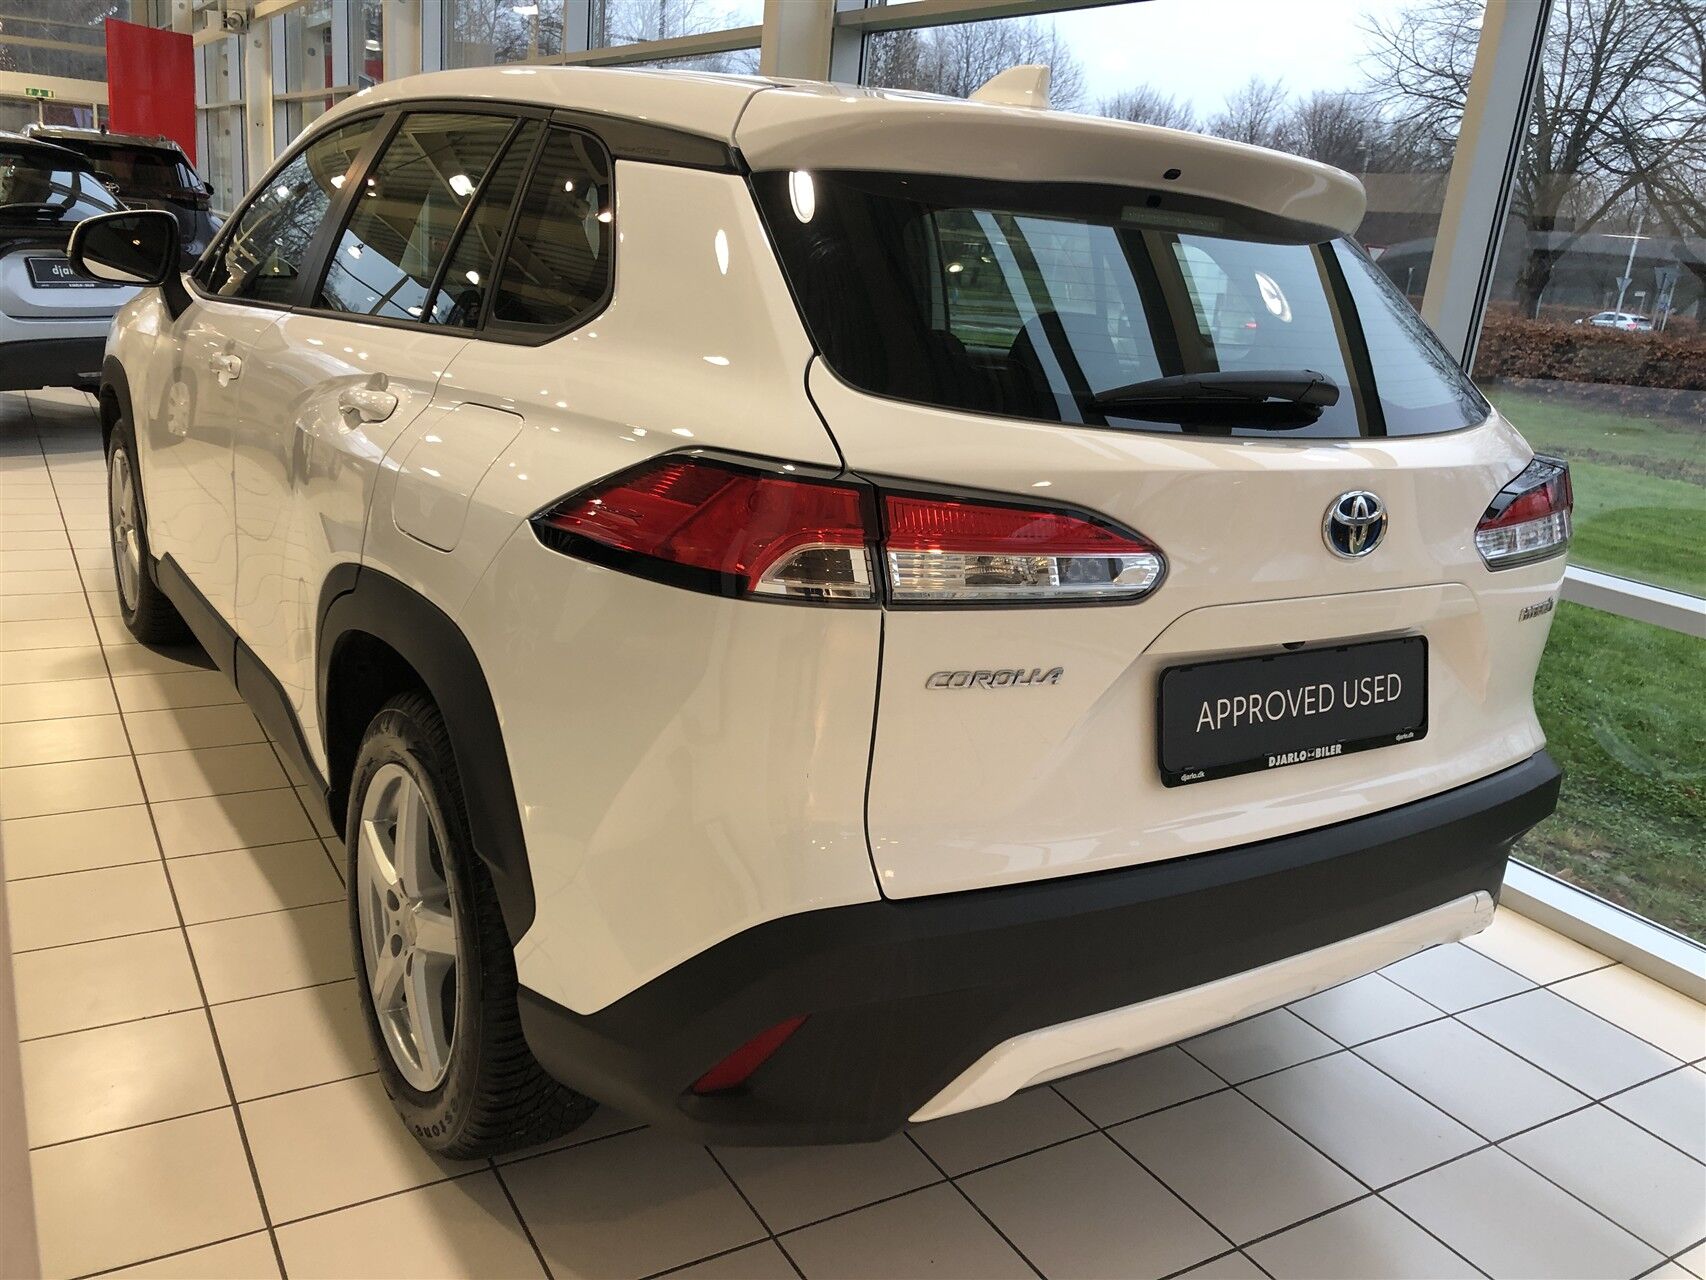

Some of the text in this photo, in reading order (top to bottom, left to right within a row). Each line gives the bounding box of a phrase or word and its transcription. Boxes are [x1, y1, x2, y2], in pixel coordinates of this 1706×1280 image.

[925, 666, 1064, 690] COROLLA
[1196, 673, 1402, 733] APPROVED USED
[1268, 744, 1342, 767] DJARLO BILER
[1180, 770, 1206, 782] djarlo.dk
